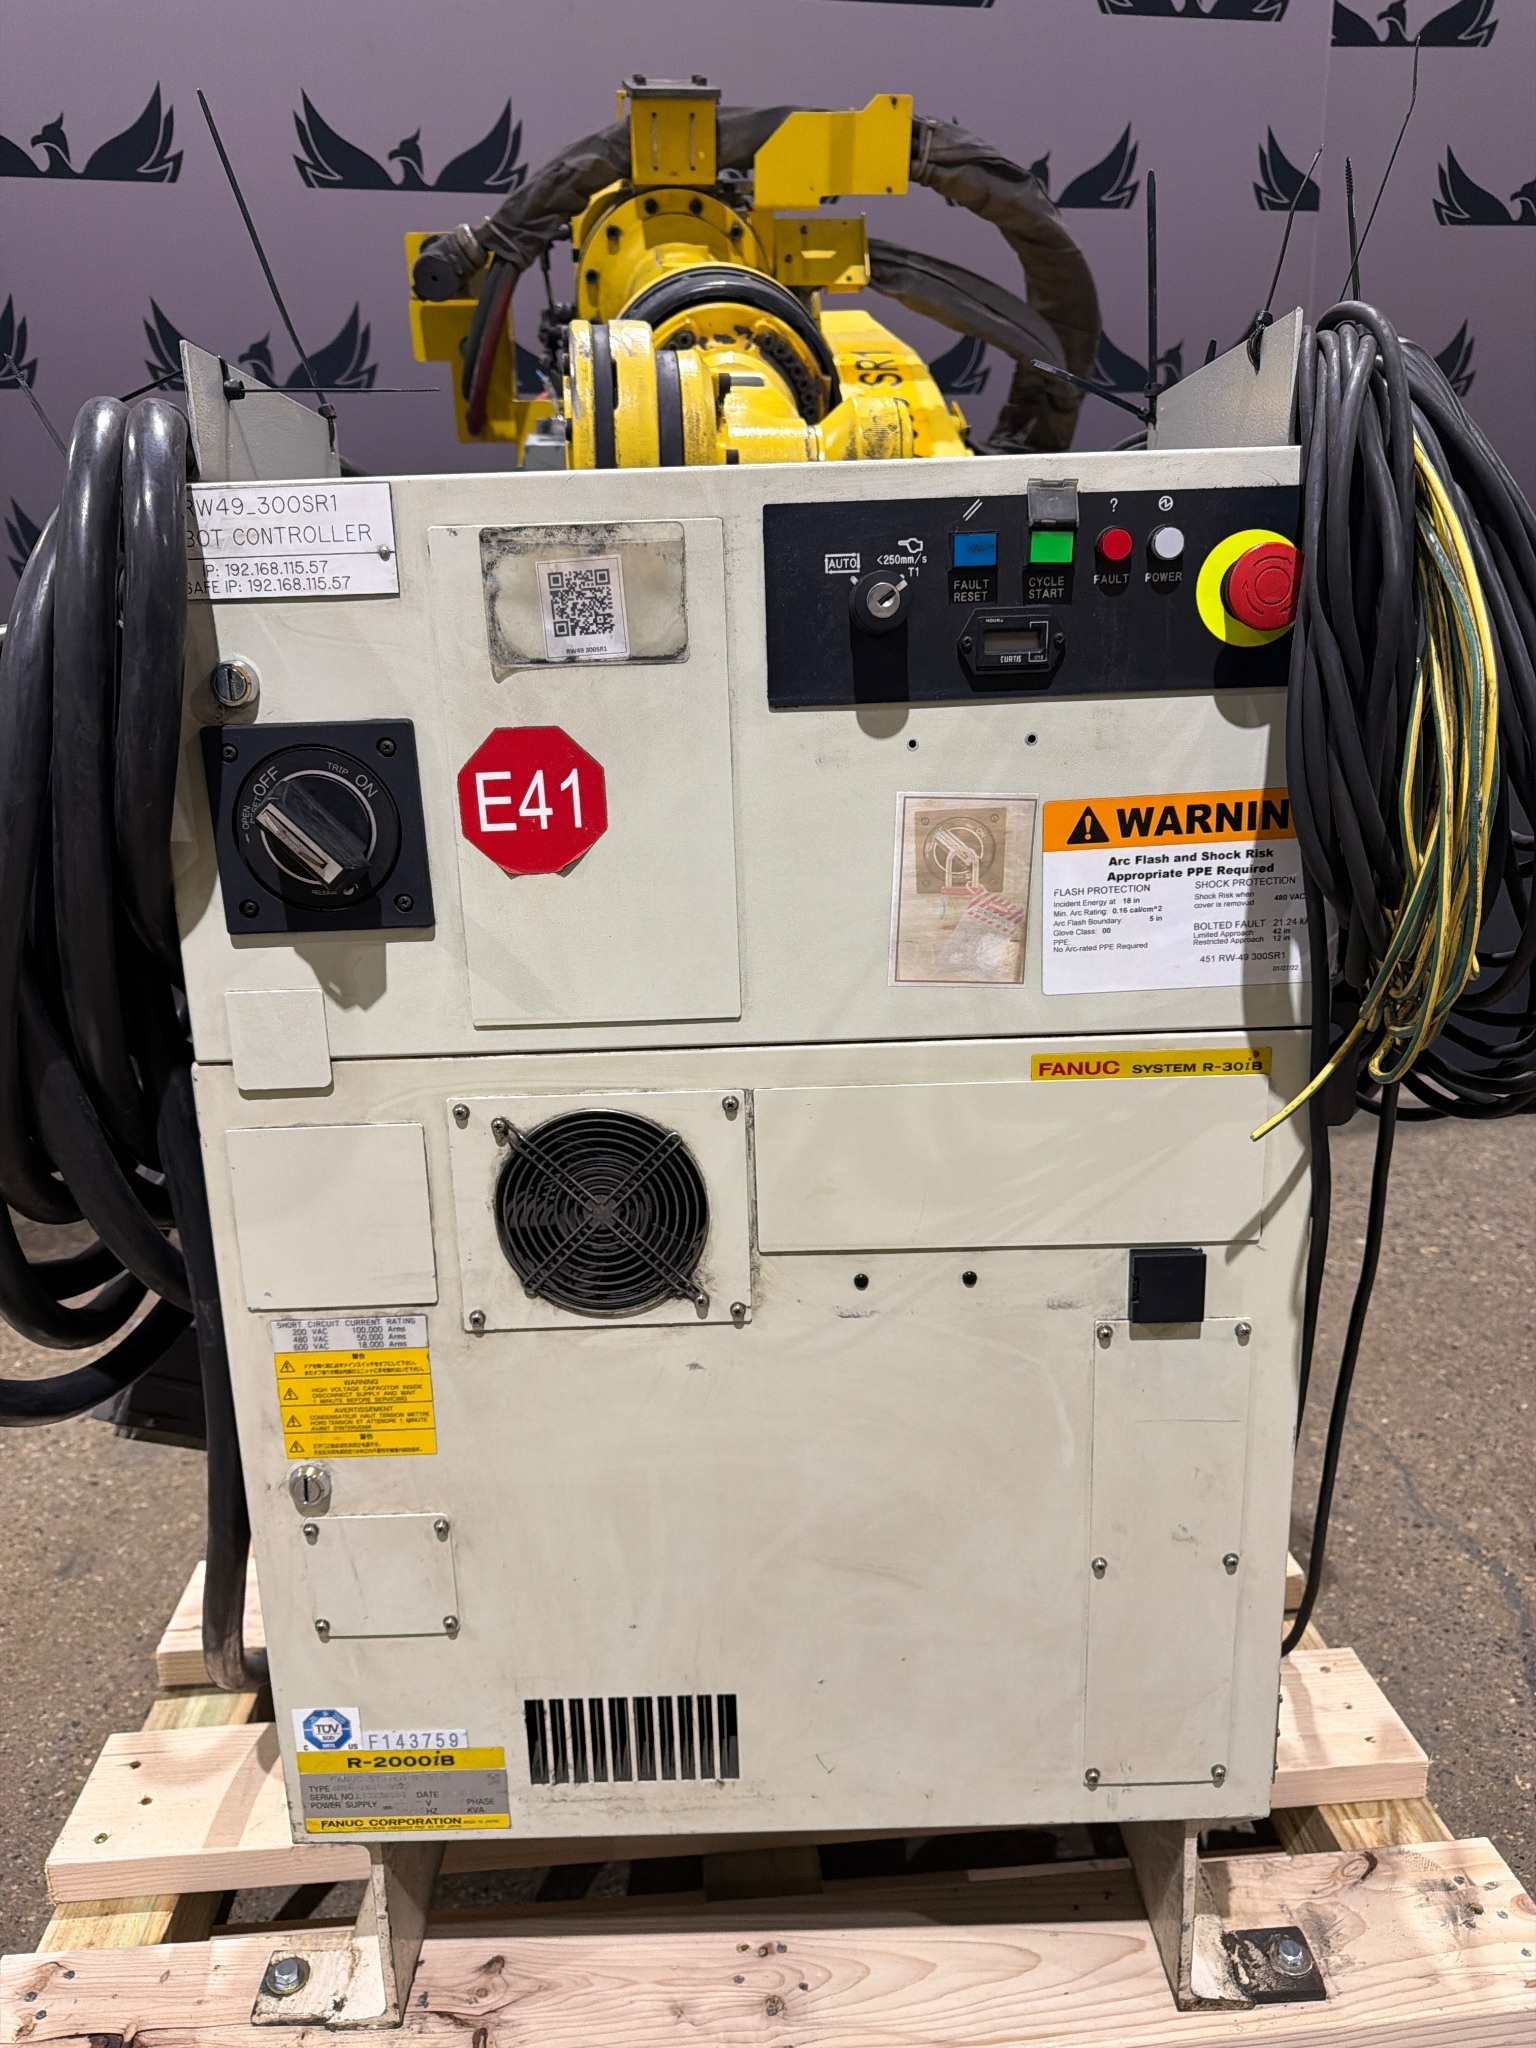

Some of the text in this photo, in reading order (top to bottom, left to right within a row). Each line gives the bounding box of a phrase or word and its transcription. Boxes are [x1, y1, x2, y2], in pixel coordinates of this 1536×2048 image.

[187, 494, 337, 516] RW49_300SR1
[187, 523, 372, 547] BOT CONTROLLER
[828, 558, 857, 569] AUTO
[876, 553, 928, 566] <250mm/s
[202, 560, 328, 577] IP: 192.168.115.57
[908, 567, 920, 577] T1
[1028, 576, 1065, 587] CYCLE
[1093, 573, 1130, 585] FAULT
[1144, 571, 1182, 583] POWER
[225, 579, 242, 593] IP:
[247, 576, 351, 593] 192.168.115.57
[953, 579, 989, 590] FAULT
[953, 591, 988, 602] RESET
[1028, 588, 1064, 599] START
[1000, 655, 1022, 663] CURTIS
[326, 761, 349, 775] TRIP
[253, 766, 279, 796] OFF
[355, 774, 379, 798] ON
[474, 767, 584, 833] E41
[241, 805, 251, 830] OPEN
[1116, 798, 1290, 838] WARNIN
[1108, 848, 1274, 867] Arc Flash and Shock Risk
[1107, 863, 1275, 883] Appropriate PPE Required
[1194, 876, 1296, 889] SHOCK PROTECTION
[1053, 884, 1151, 897] FLASH PROTECTION
[1053, 900, 1081, 908] Incident
[1082, 899, 1107, 907] Energy
[1053, 910, 1067, 918] Min.
[1069, 909, 1082, 917] Arc
[1083, 908, 1108, 917] Rating:
[1193, 921, 1233, 931] BOLTED
[1235, 919, 1266, 929] FAULT
[1273, 918, 1297, 927] 21.24
[1053, 929, 1074, 937] Glove
[1075, 928, 1097, 936] Class:
[1193, 931, 1218, 939] Limited
[1220, 929, 1254, 938] Approach
[1116, 942, 1148, 951] Required
[1193, 938, 1229, 946] Restricted
[1230, 936, 1264, 944] Approach
[1200, 952, 1286, 963] 451 RW-49 300SR1
[1038, 1058, 1263, 1077] FANUC SYSTEM R-30iB
[307, 1320, 339, 1328] CIRCUIT
[345, 1319, 381, 1327] CURRENT
[386, 1317, 416, 1325] RATING
[292, 1328, 307, 1336] 200
[312, 1335, 329, 1343] VAC
[313, 1342, 330, 1350] VAC
[368, 1732, 460, 1750] F143759
[347, 1750, 455, 1768] R-2000iB
[308, 1785, 330, 1793] TYPE
[309, 1793, 340, 1801] SERIAL
[416, 1791, 439, 1799] DATE
[310, 1801, 377, 1809] POWER SUPPLY
[425, 1799, 432, 1807] V
[466, 1798, 495, 1806] PHASE
[467, 1806, 484, 1814] KVA
[321, 1819, 364, 1828] FANUC
[368, 1817, 462, 1827] CORPORATION
